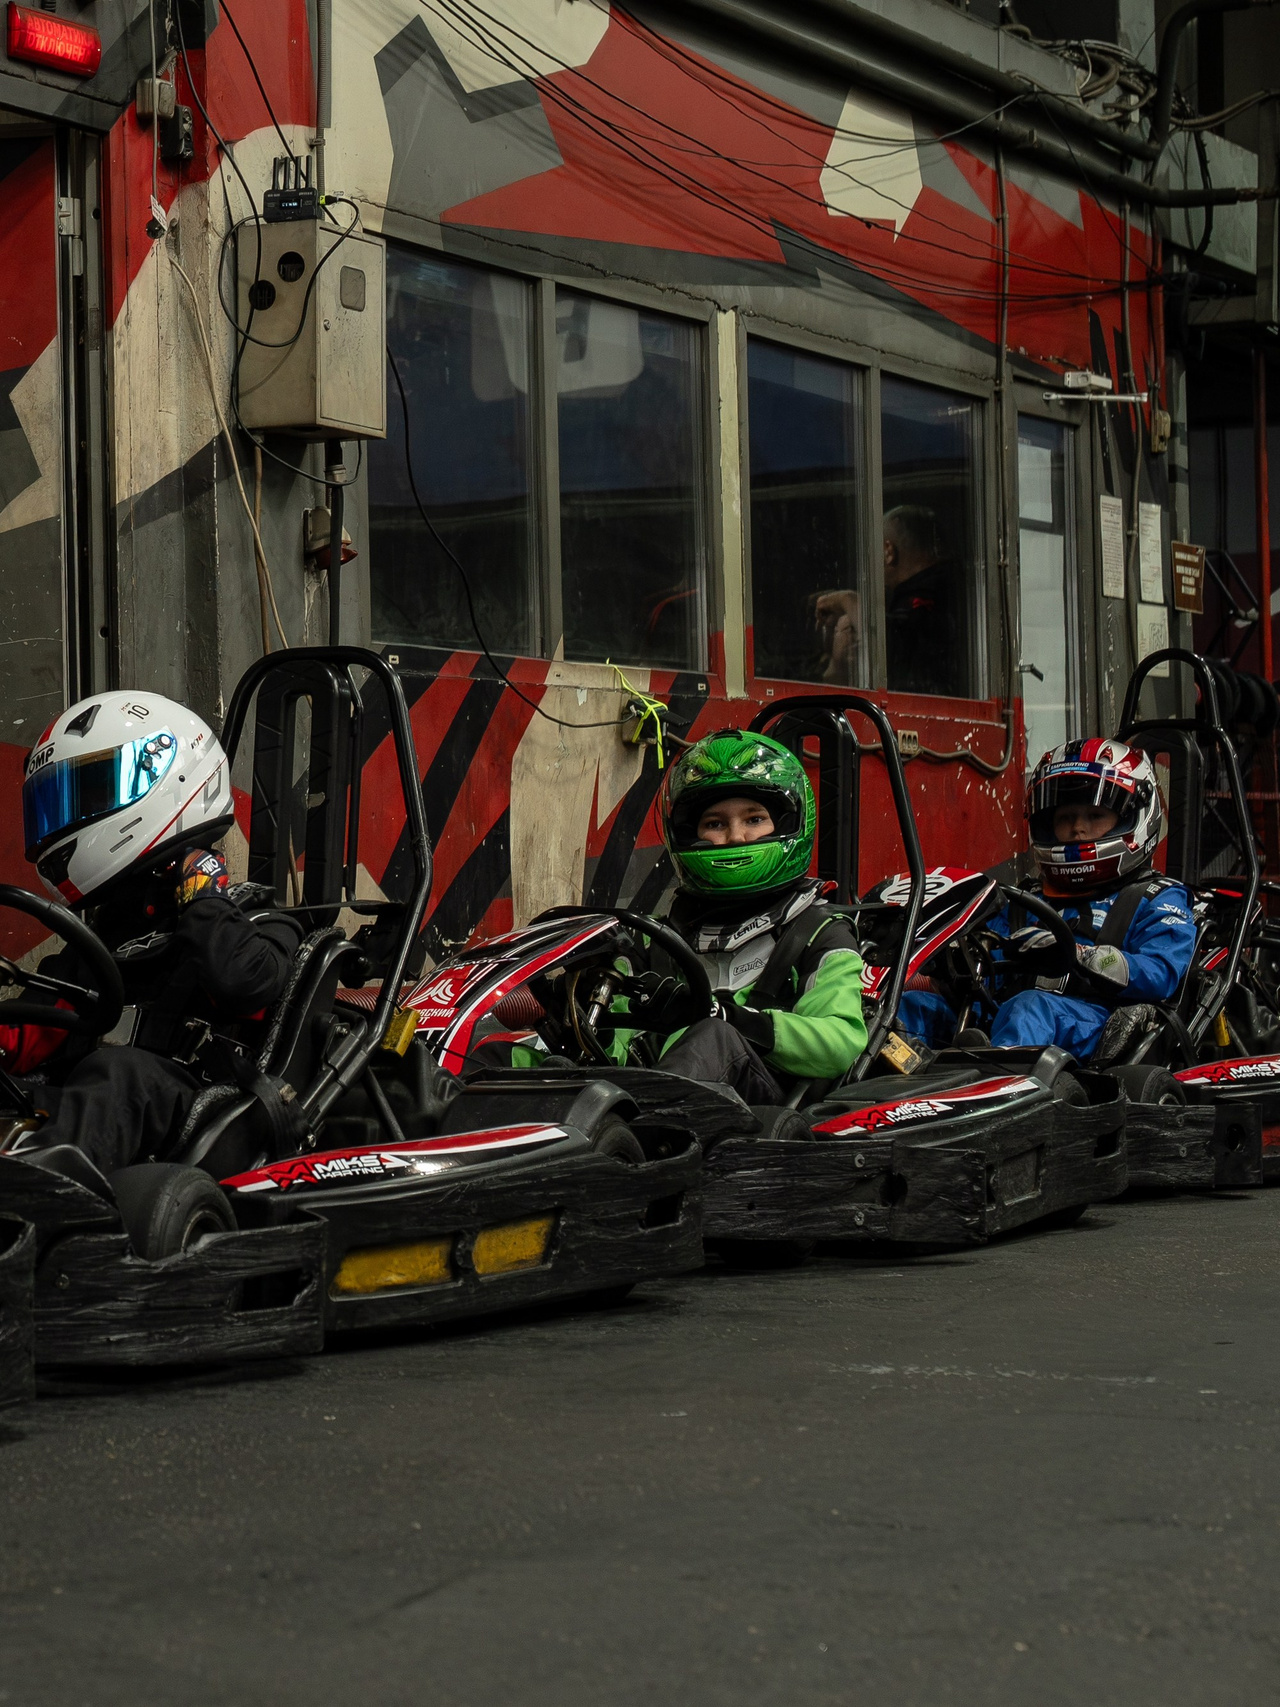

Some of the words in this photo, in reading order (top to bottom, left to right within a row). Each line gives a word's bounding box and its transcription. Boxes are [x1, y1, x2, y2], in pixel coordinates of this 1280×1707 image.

[27, 31, 92, 63] ОТКЛЮЧЕН
[127, 704, 150, 720] 10
[28, 748, 55, 774] OMP
[201, 858, 219, 874] OMP
[1060, 865, 1095, 875] ЛУКОЙЛ
[1230, 1063, 1272, 1075] MIKS
[315, 1154, 380, 1174] MIKS
[320, 1165, 385, 1180] KARTING
